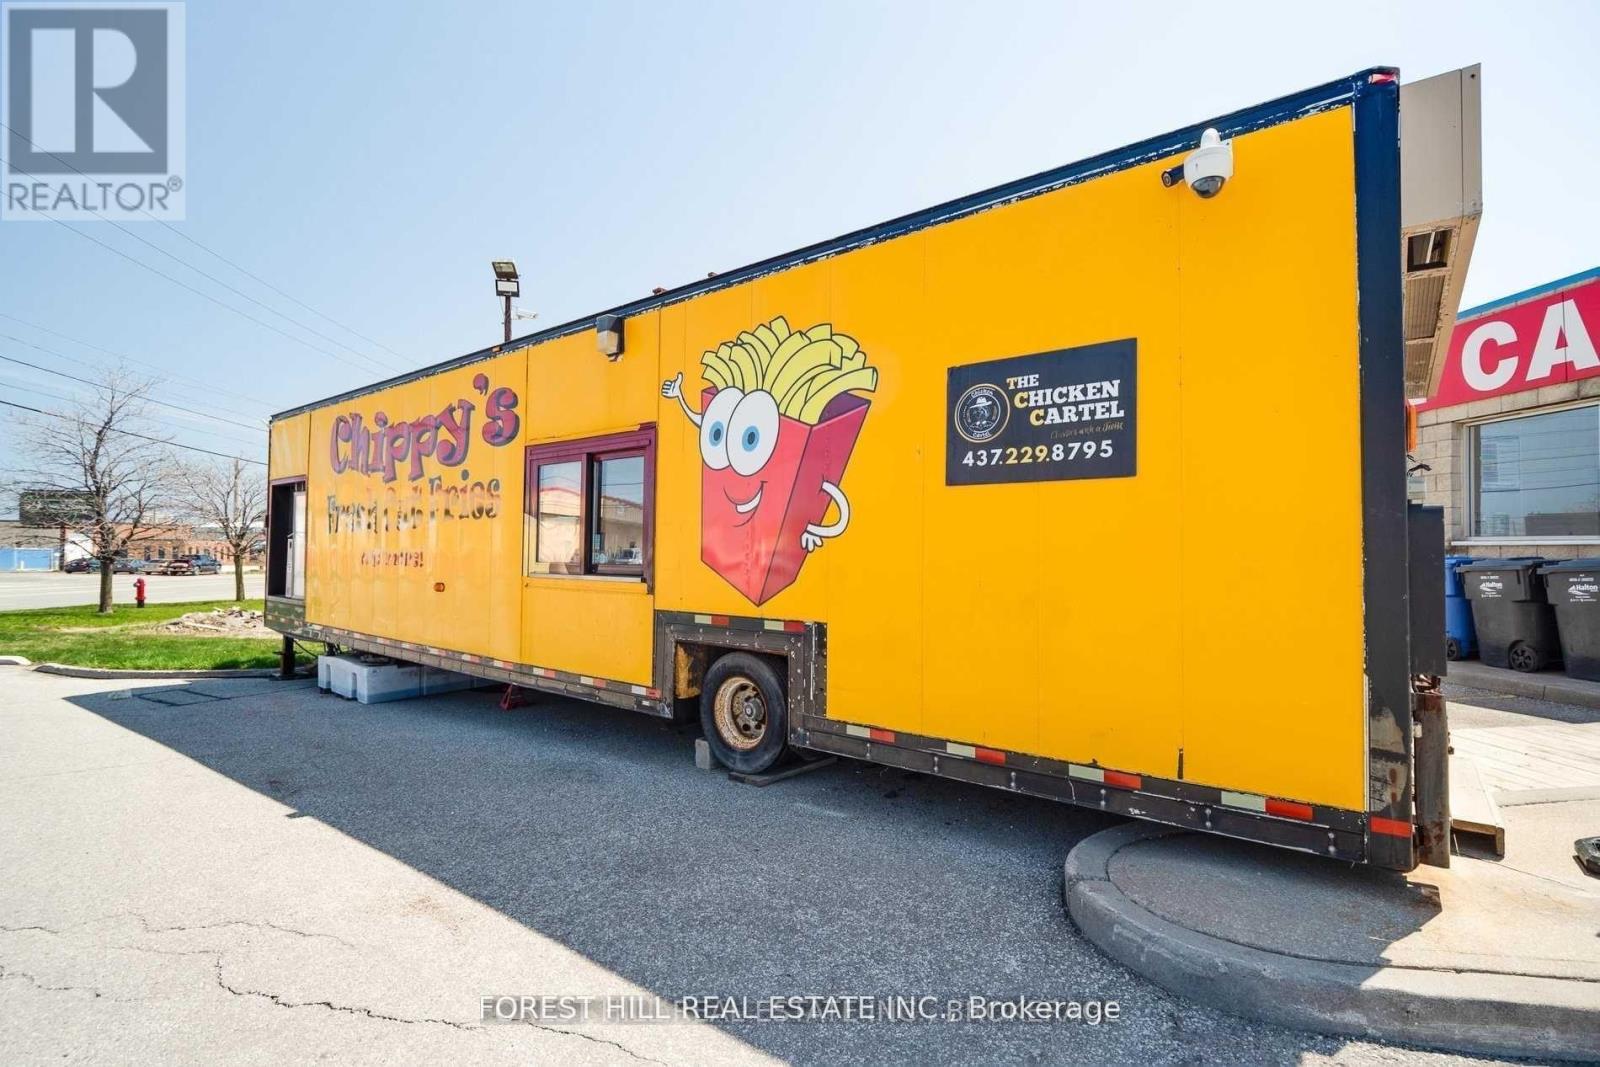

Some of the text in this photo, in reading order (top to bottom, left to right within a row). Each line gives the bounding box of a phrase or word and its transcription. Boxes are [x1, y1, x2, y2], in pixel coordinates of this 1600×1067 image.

[1006, 374, 1039, 390] THE
[1014, 380, 1121, 409] CHICKEN
[1029, 400, 1125, 426] CARTEL
[330, 373, 520, 484] Chippy's
[962, 440, 1113, 467] 437.229.8795
